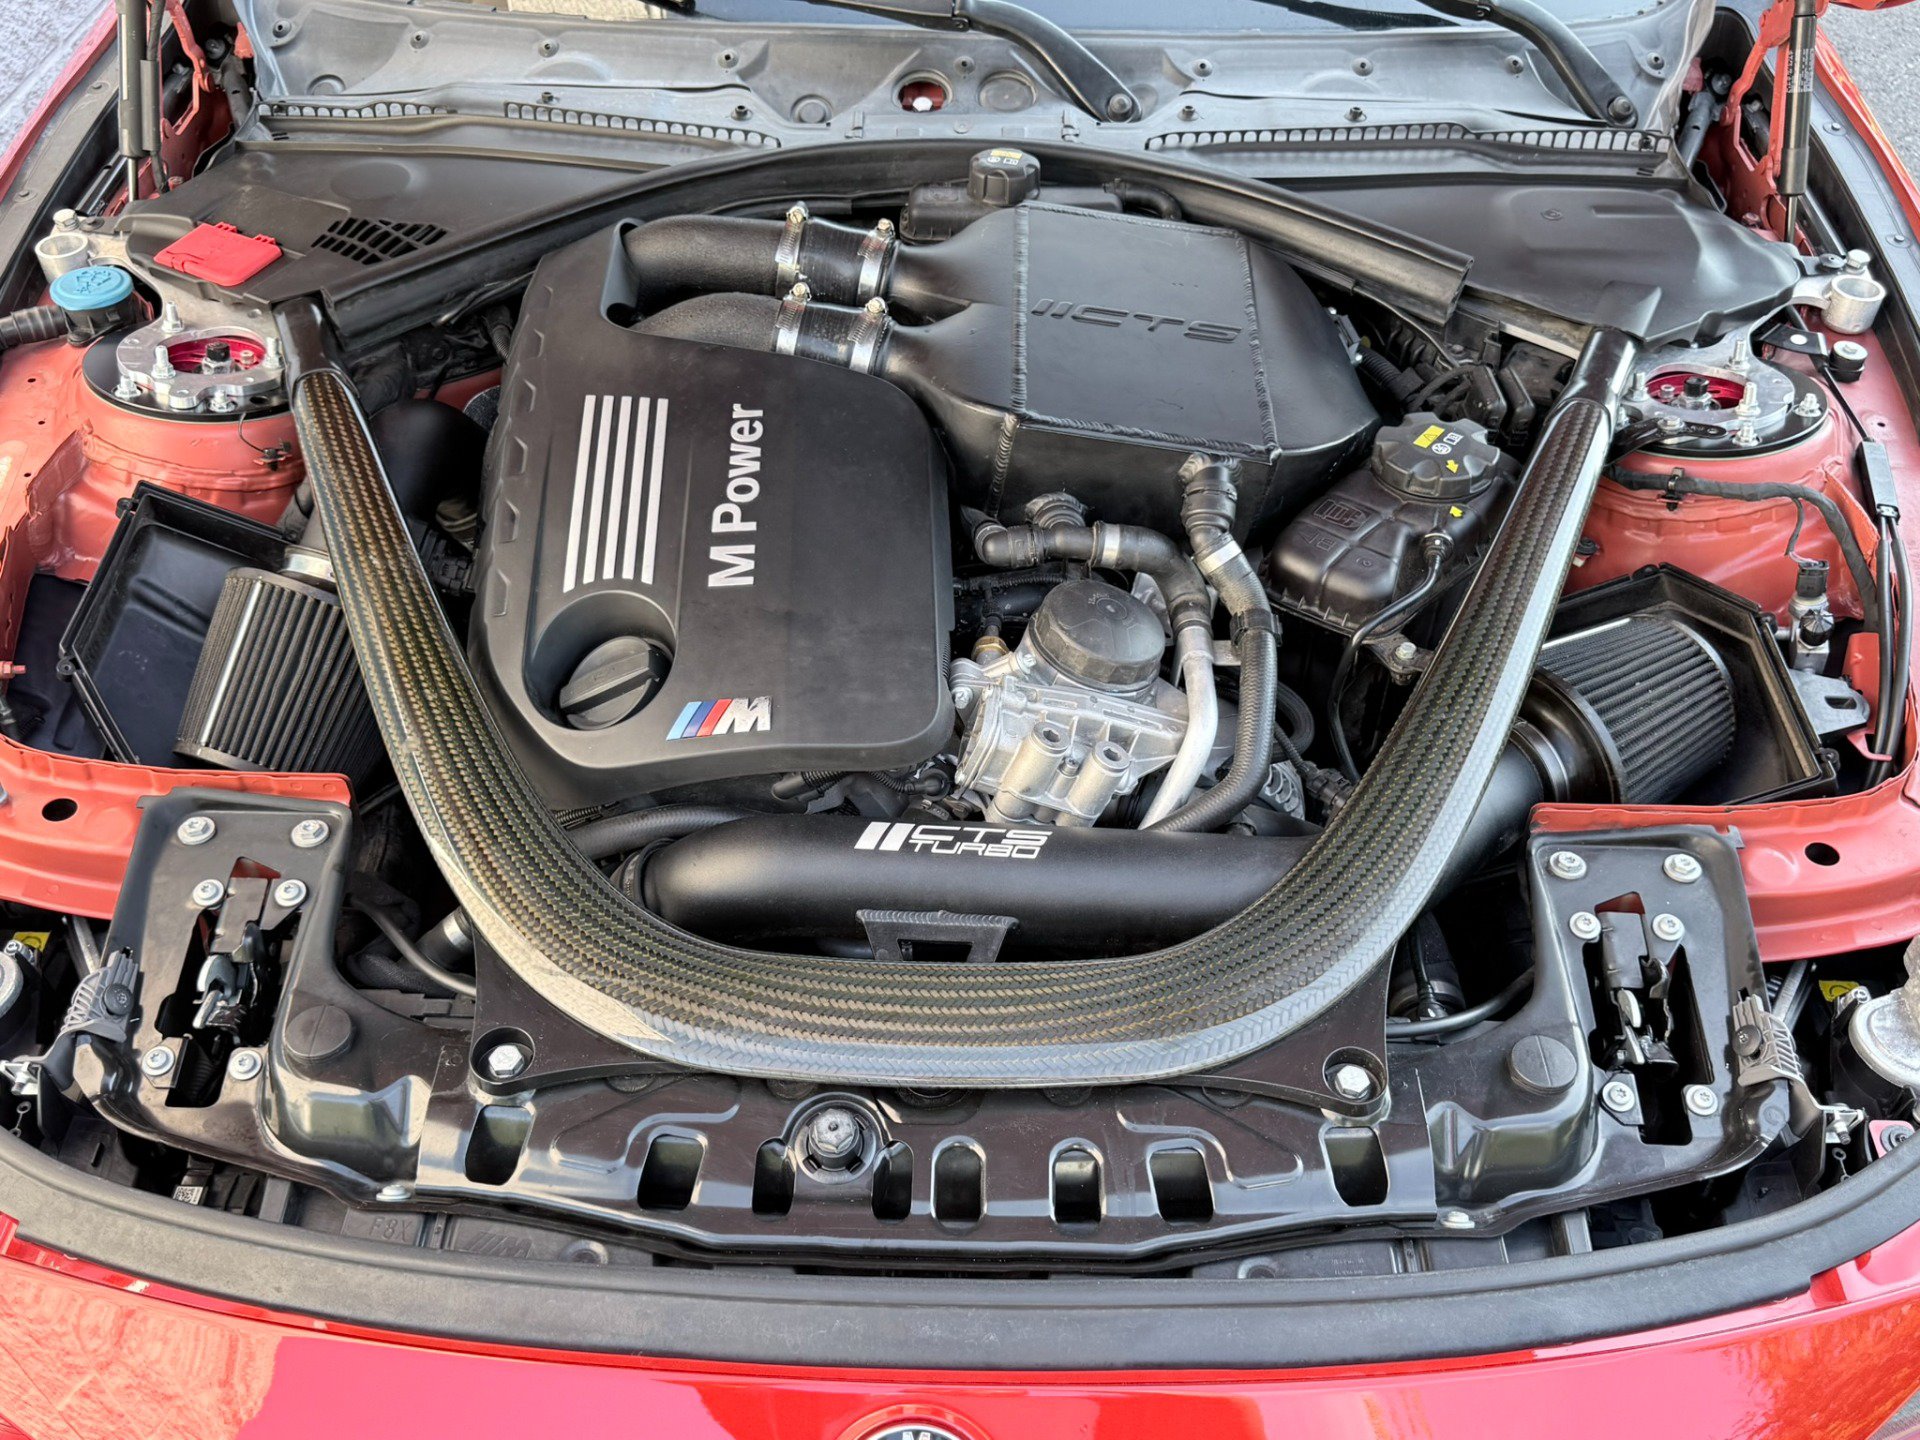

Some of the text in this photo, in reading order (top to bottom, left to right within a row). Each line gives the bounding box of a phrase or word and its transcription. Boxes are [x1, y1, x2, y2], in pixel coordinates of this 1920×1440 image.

[1070, 303, 1243, 344] CTS
[707, 403, 764, 587] M Power
[908, 839, 1041, 860] TURBO
[911, 825, 1053, 846] CTS
